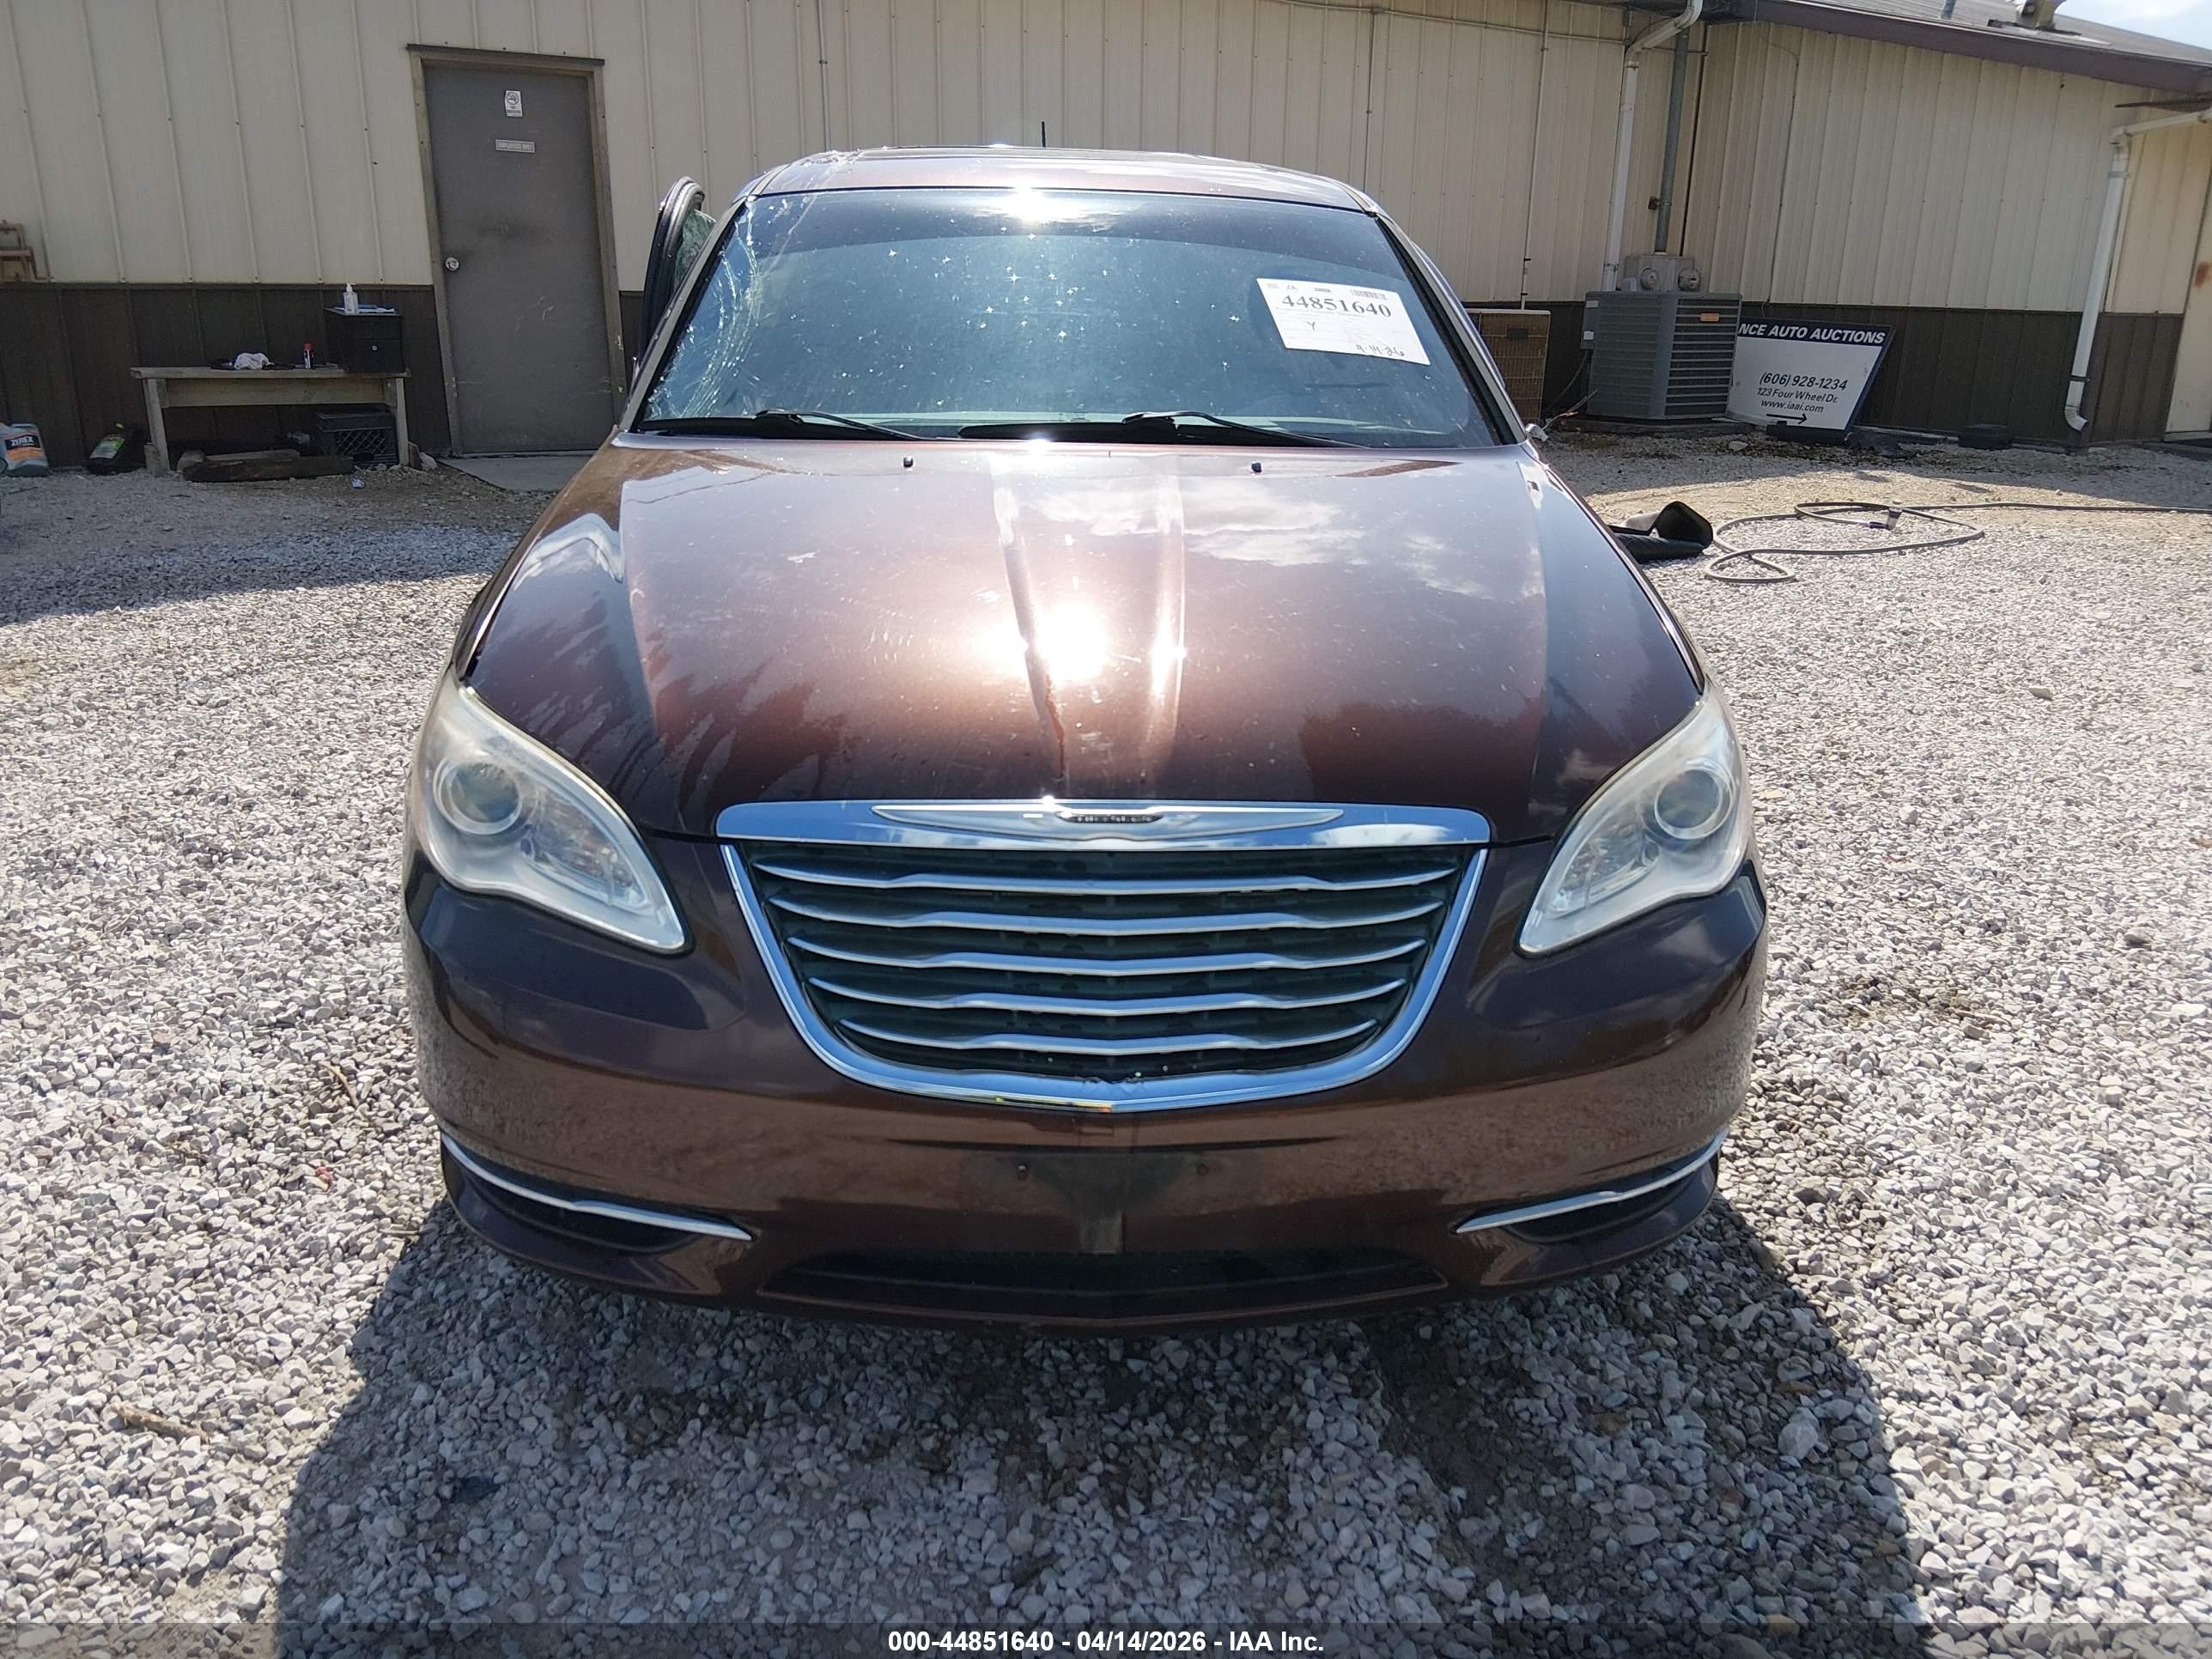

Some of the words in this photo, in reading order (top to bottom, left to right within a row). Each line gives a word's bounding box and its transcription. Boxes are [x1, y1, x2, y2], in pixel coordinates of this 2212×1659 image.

[1282, 295, 1392, 318] 44851640
[1738, 323, 1767, 336] NCE
[1768, 325, 1808, 339] AUTO
[1809, 328, 1887, 344] AUCTIONS
[1759, 372, 1791, 387] (606)
[1791, 375, 1848, 391] 928-1234
[1757, 387, 1772, 397] 123
[1772, 389, 1795, 399] Four
[1795, 391, 1826, 402] Wheel
[1826, 394, 1838, 404] Dr.
[1760, 399, 1824, 413] www.iaai.com
